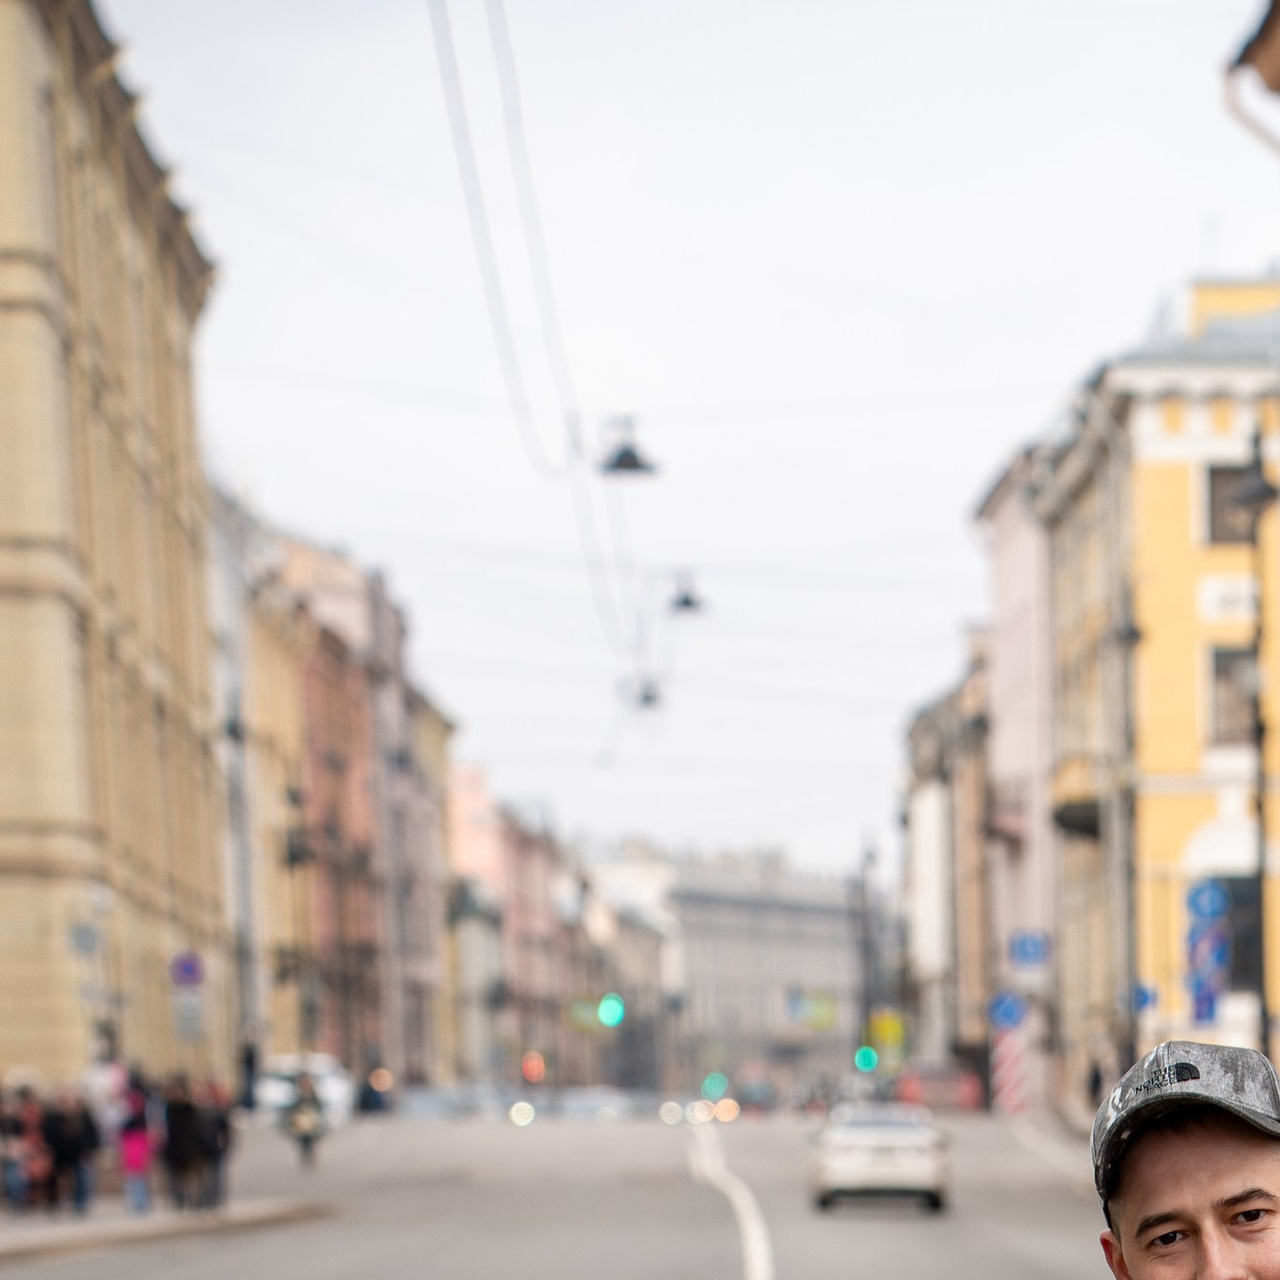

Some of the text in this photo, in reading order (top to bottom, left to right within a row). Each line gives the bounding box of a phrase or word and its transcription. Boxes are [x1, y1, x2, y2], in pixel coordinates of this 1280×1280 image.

[1151, 1065, 1175, 1078] THE
[1135, 1070, 1177, 1095] NORTH
[1146, 1076, 1177, 1094] FACE
